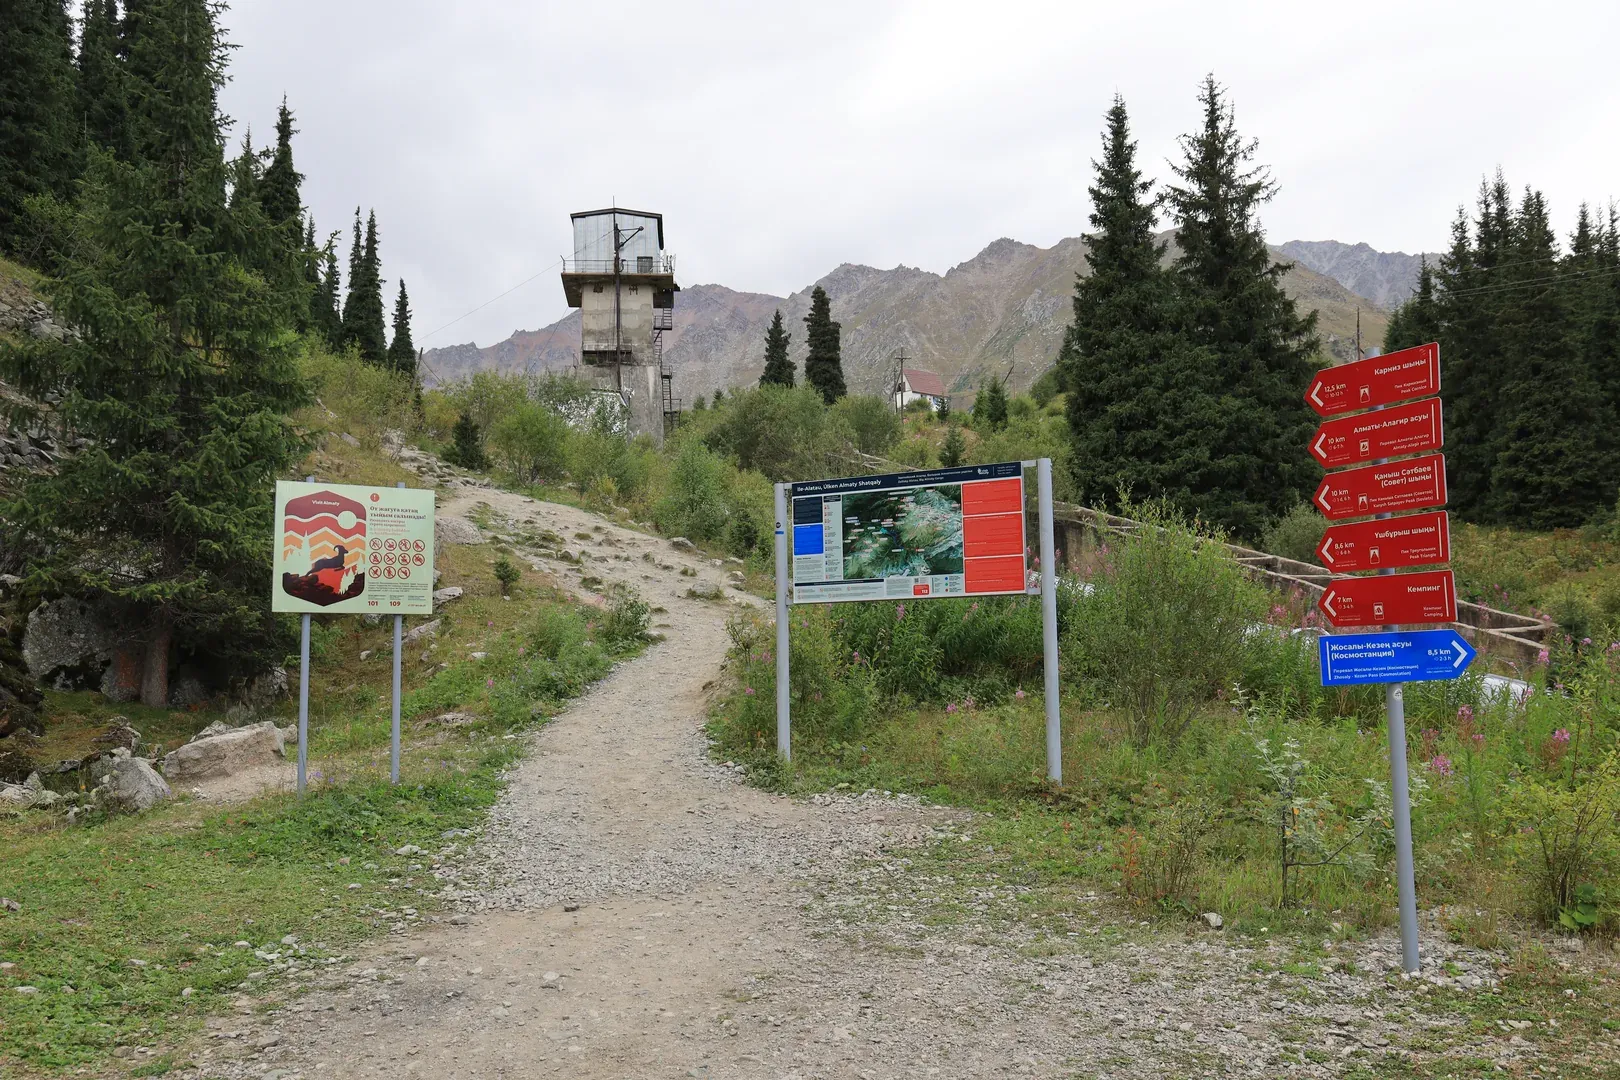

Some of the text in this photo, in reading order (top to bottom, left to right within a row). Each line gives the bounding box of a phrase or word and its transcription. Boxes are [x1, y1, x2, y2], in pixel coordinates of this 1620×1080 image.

[1374, 359, 1426, 376] Карниз шыңы
[1353, 413, 1429, 434] Алматы-Алагир асуы
[1374, 471, 1400, 480] Қаныш
[1381, 474, 1432, 488] (Совет) шыңы
[1412, 526, 1435, 535] шыңы
[1330, 641, 1412, 651] Жосалы-Кезең асуы
[1331, 650, 1395, 661] (Космостанция)
